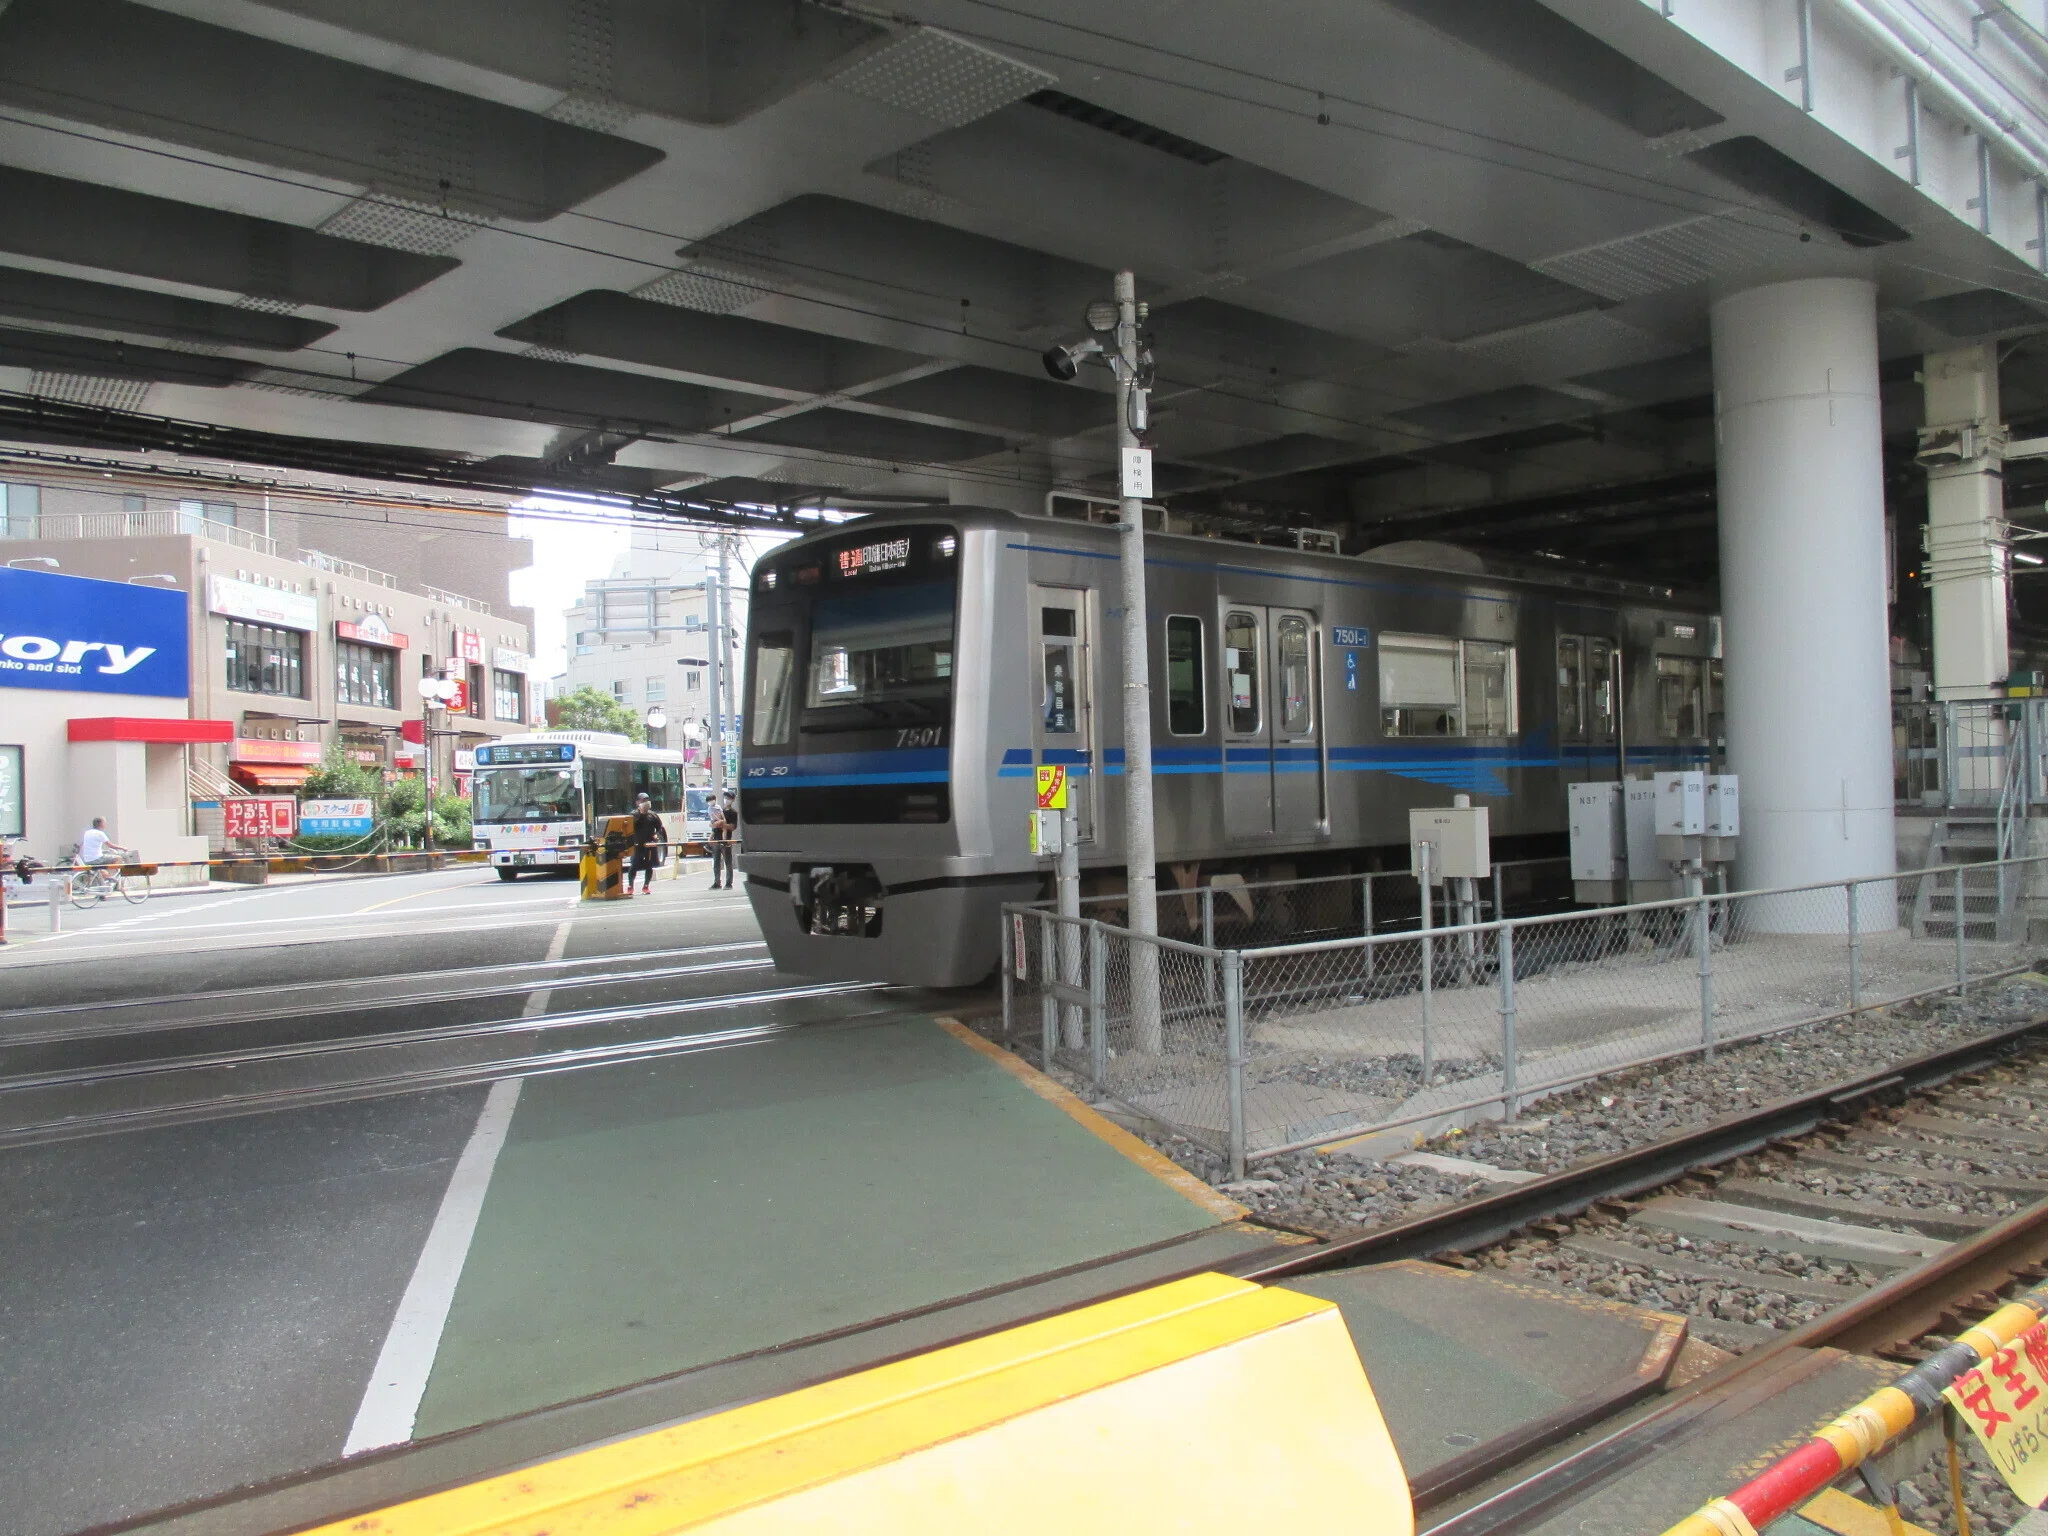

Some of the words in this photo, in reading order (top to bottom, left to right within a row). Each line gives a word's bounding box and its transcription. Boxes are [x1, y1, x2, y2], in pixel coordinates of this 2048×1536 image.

[1132, 455, 1144, 491] 障検用
[839, 548, 863, 569] 普通
[1335, 629, 1367, 645] 7501-1
[0, 633, 157, 675] ory
[27, 662, 54, 672] and
[56, 664, 83, 675] slot
[897, 726, 943, 748] 7501
[1579, 796, 1597, 805] N3T
[230, 803, 269, 819] やる気
[228, 819, 272, 836] スイッチ
